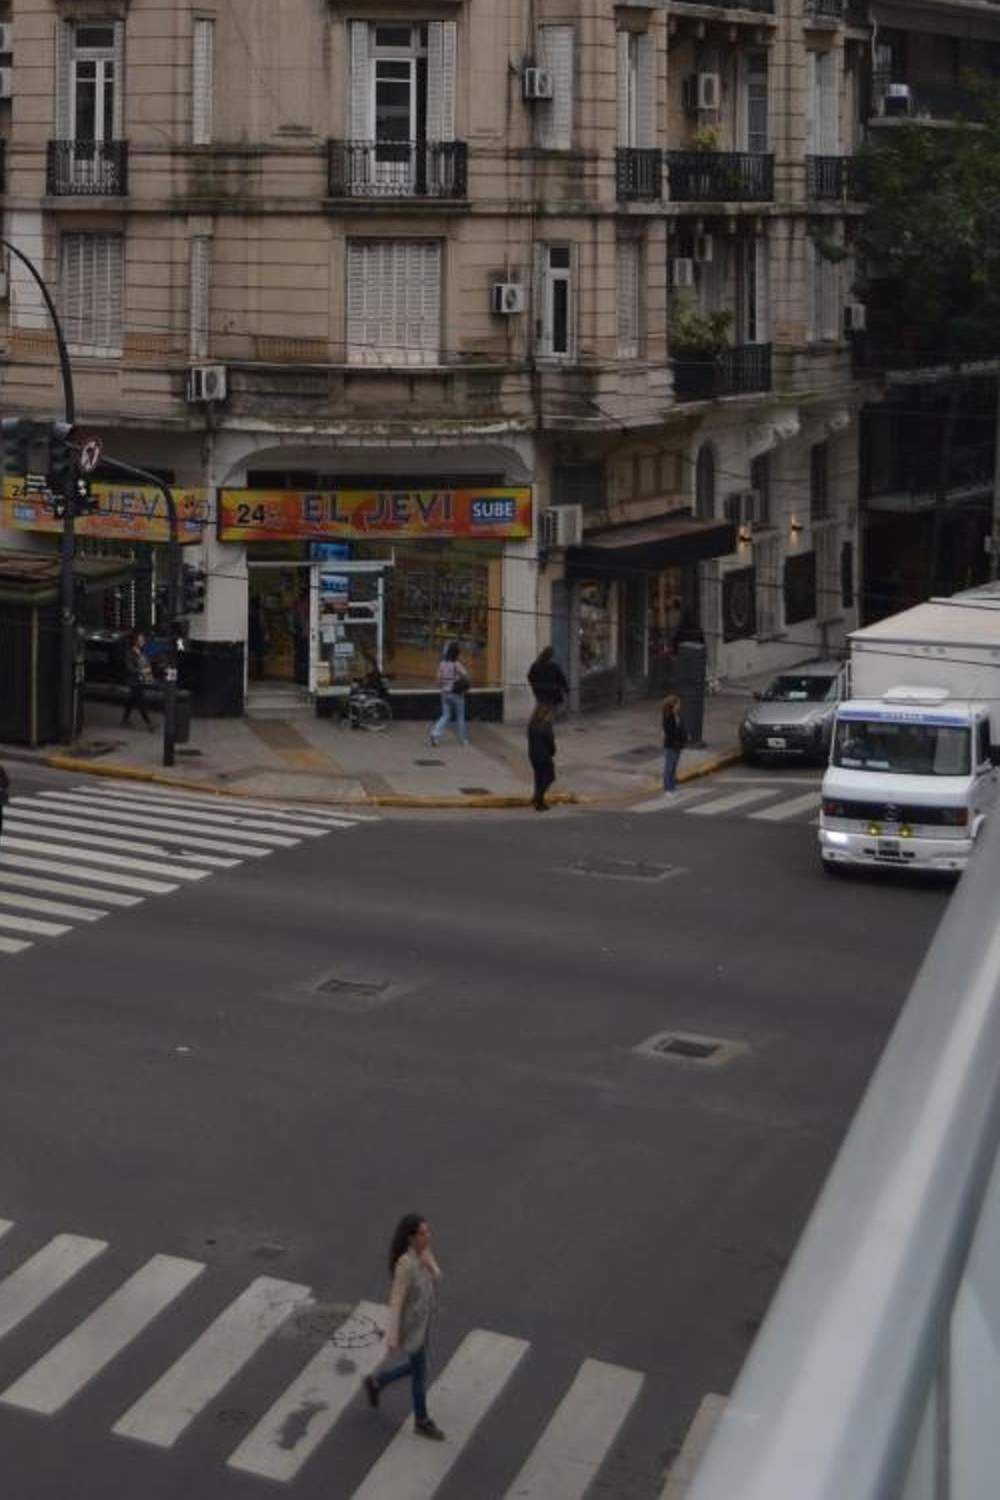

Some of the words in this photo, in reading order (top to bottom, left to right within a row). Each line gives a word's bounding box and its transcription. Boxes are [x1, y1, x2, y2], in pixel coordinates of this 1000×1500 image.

[235, 502, 267, 525] 24
[301, 492, 350, 524] EL
[366, 492, 455, 524] JEVI
[471, 499, 514, 519] SUBE
